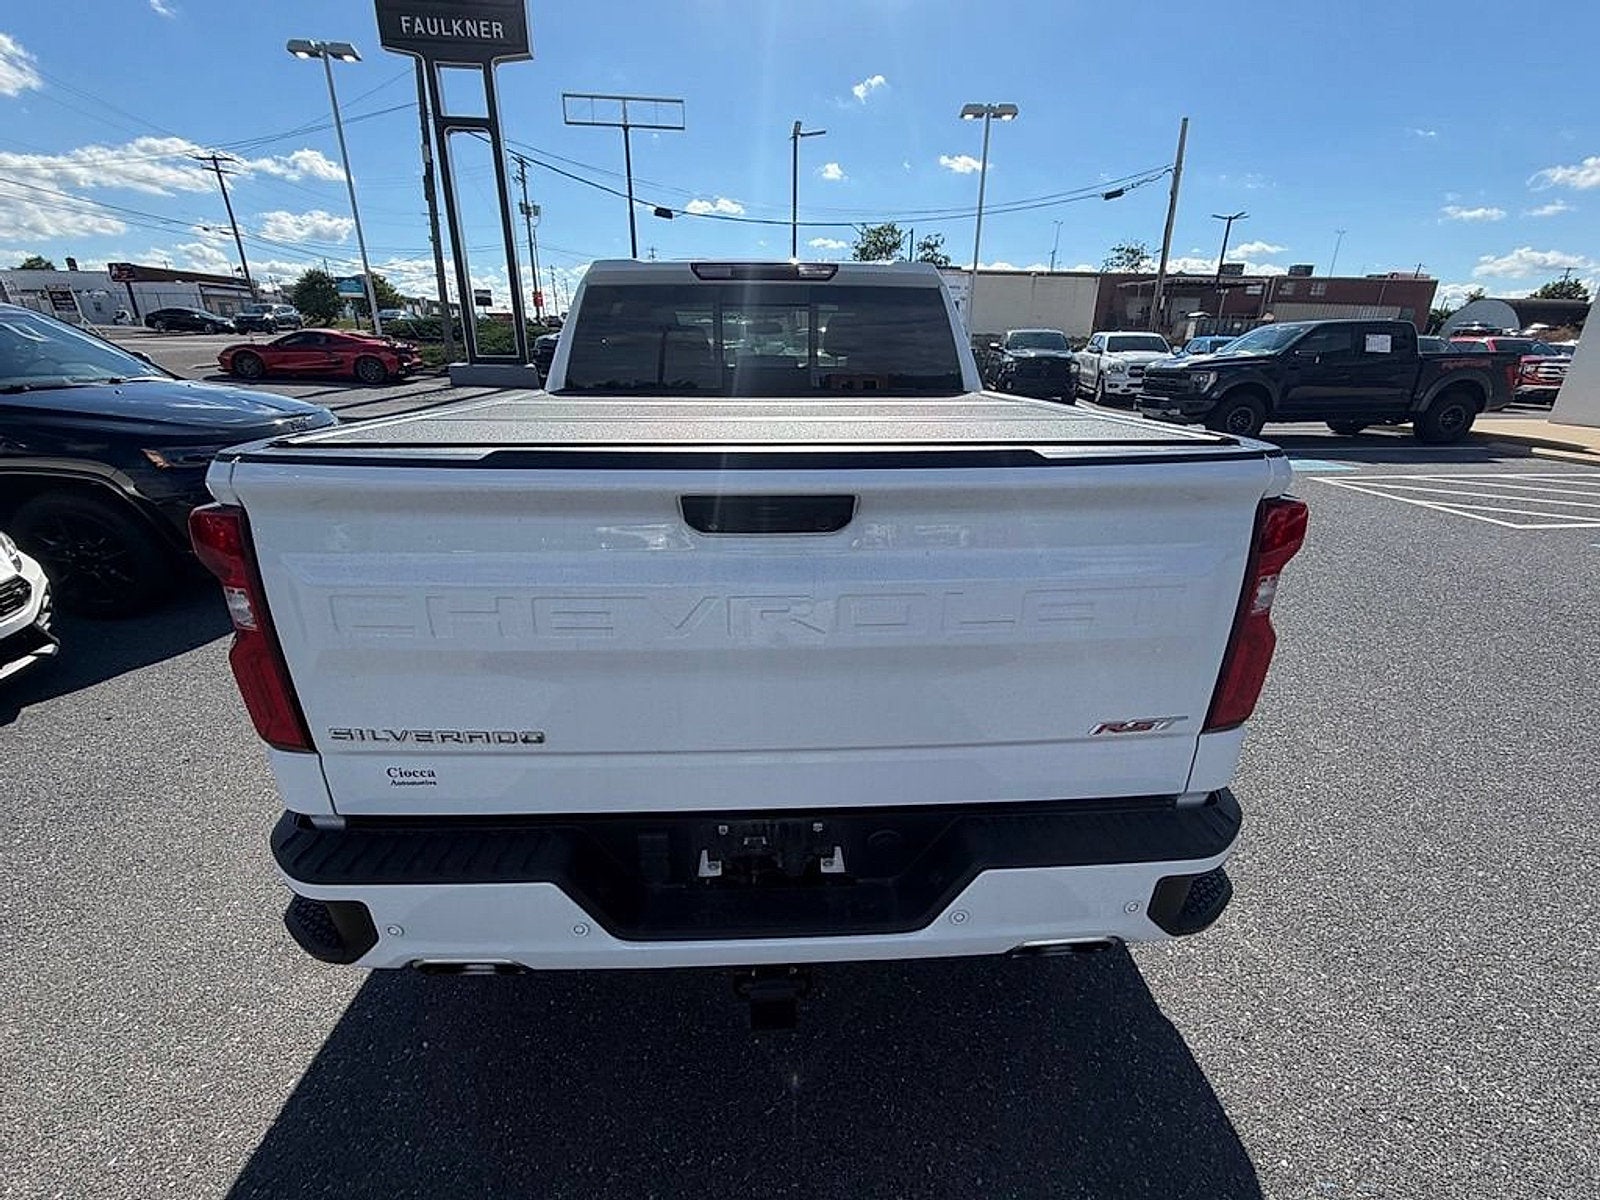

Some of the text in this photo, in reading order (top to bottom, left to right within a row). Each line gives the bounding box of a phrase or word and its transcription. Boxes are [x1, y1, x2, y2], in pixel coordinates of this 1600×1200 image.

[400, 15, 504, 39] FAULKNER
[328, 584, 1188, 643] CHEVROLET
[328, 728, 546, 744] SILVERADO
[1087, 715, 1189, 736] RST
[386, 767, 436, 778] Ciocca
